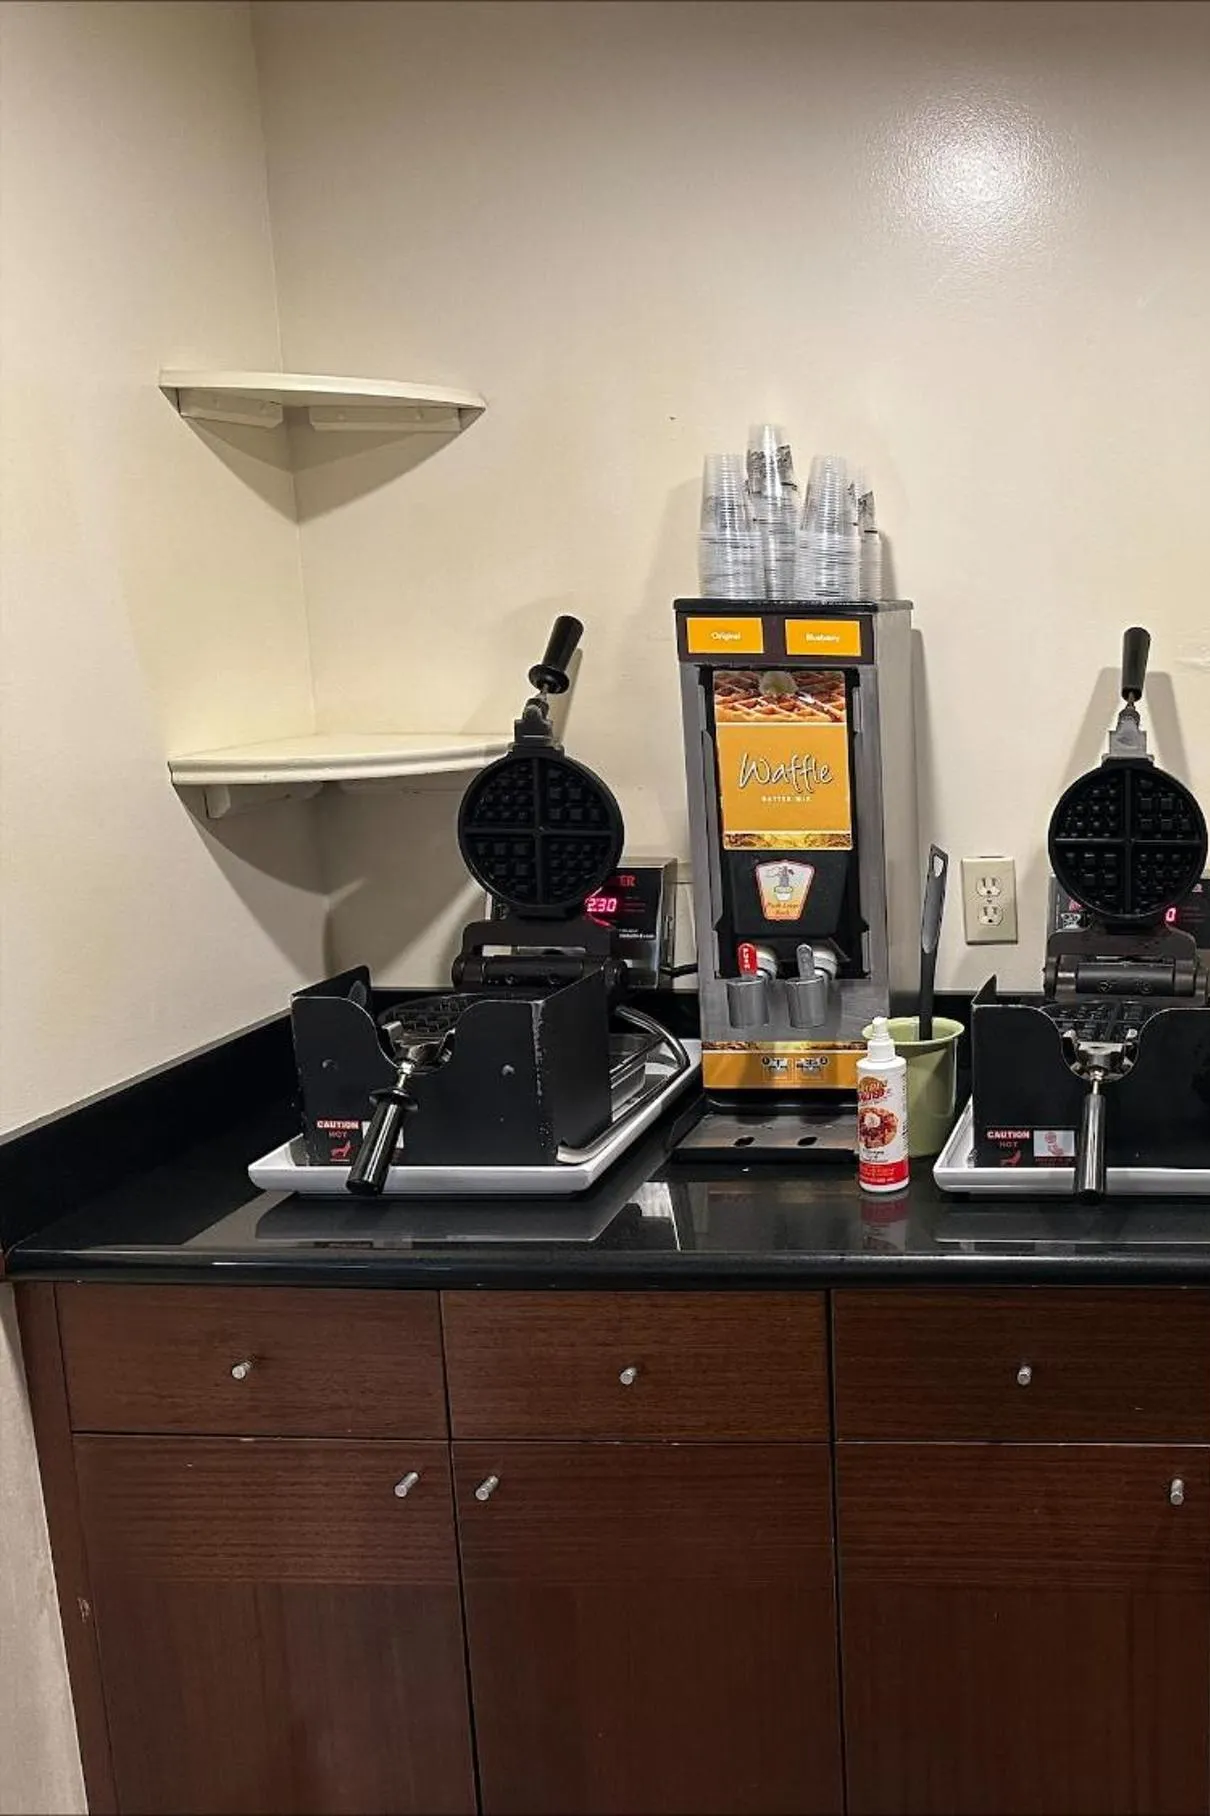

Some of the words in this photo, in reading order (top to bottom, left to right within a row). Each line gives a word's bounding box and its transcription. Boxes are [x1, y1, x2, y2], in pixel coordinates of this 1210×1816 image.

[710, 631, 741, 642] Original
[738, 752, 834, 794] Waffle
[585, 897, 618, 913] 230
[316, 1120, 360, 1130] CAUTION
[986, 1130, 1031, 1140] CAUTION
[1000, 1140, 1019, 1149] HOT
